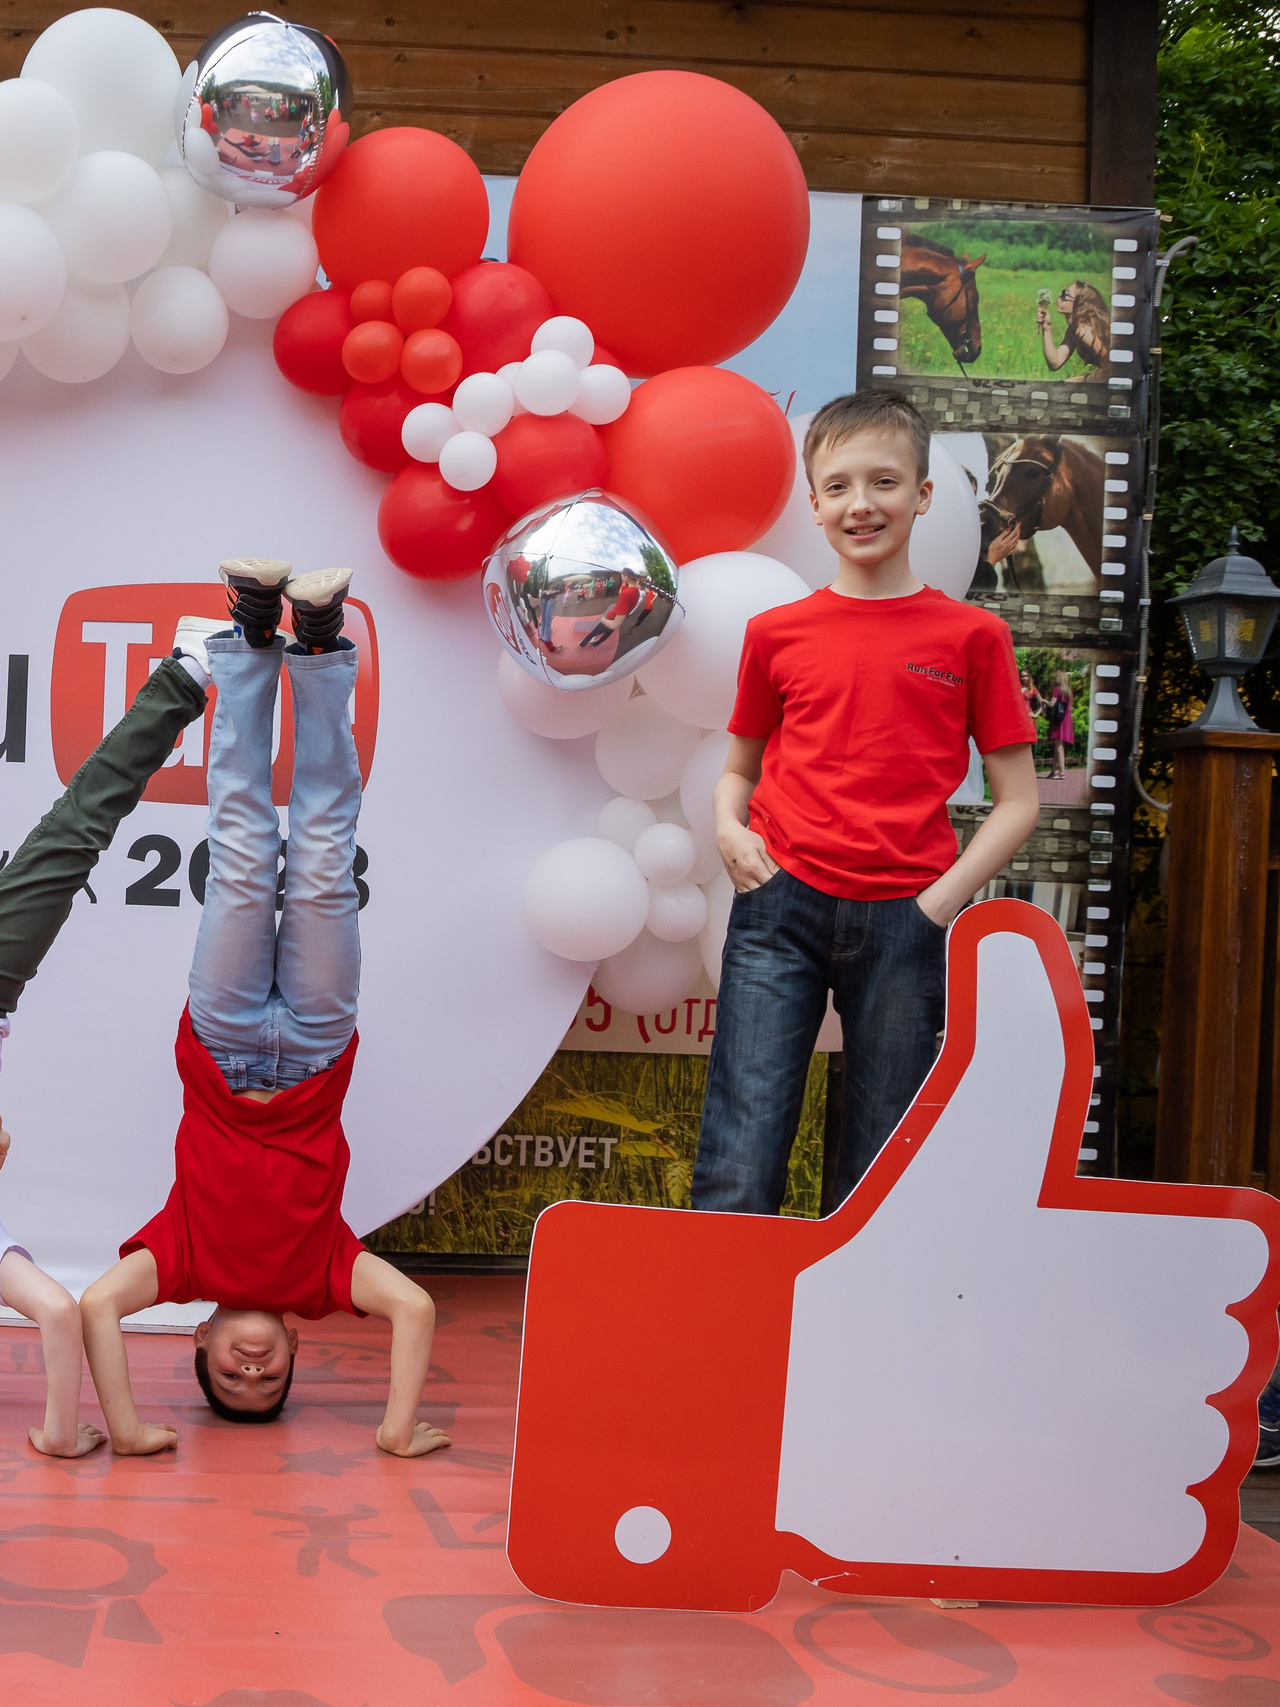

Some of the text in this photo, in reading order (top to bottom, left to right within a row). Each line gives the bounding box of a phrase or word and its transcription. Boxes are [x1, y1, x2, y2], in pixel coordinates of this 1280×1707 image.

[906, 662, 927, 675] Run
[928, 667, 945, 679] For
[945, 671, 964, 685] Fun
